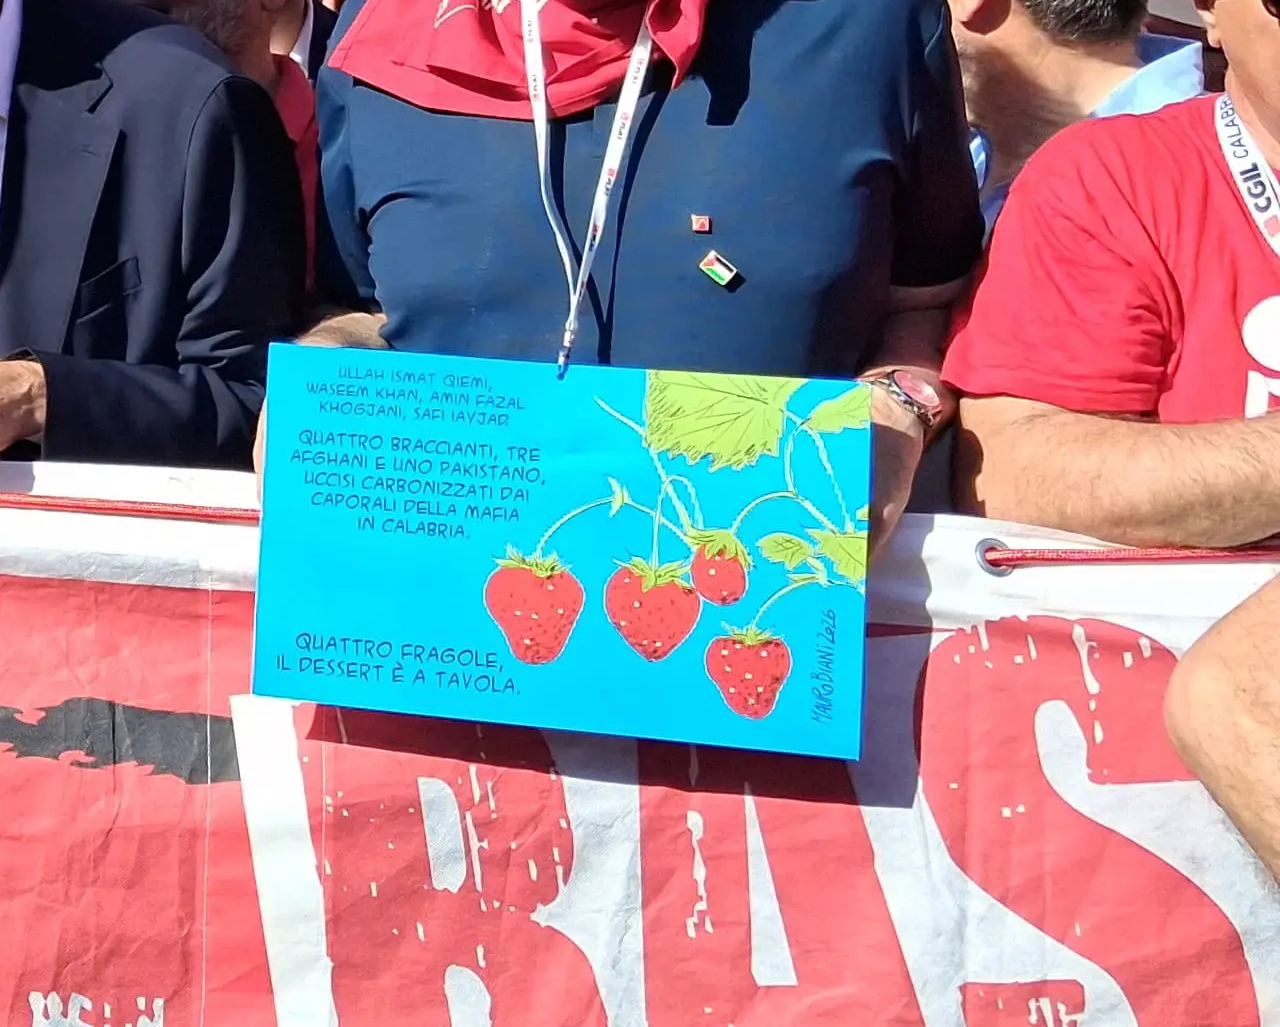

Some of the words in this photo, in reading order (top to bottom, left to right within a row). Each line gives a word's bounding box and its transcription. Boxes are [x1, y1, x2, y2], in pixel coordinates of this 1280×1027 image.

[1239, 162, 1272, 213] CGIL
[338, 367, 384, 381] ULLAH
[391, 370, 435, 384] ISMAT
[306, 383, 369, 397] WASEEM
[375, 387, 422, 403] KHAN,
[430, 392, 470, 406] AMIN
[476, 395, 525, 410] FAZAL
[413, 408, 444, 421] SAFI
[299, 429, 384, 451] QUATTRO
[390, 436, 498, 462] BRACCIANTI,
[506, 445, 541, 462] TRE
[290, 449, 368, 469] AFGHANI
[375, 456, 386, 470] E
[393, 457, 433, 474] UNO
[439, 461, 546, 486] PAKISTANO,
[304, 471, 356, 488] UCCISI
[361, 475, 493, 501] CARBONIZZATI
[500, 487, 529, 503] DAI
[311, 492, 397, 513] CAPORALI
[403, 500, 458, 517] DELLA
[465, 505, 520, 522] MAFIA
[358, 518, 375, 531] IN
[382, 519, 470, 539] CALABRIA.
[295, 632, 393, 659] QUATTRO
[401, 644, 504, 672] FRAGOLE,
[276, 654, 291, 671] IL
[298, 657, 384, 682] DESSERT
[392, 662, 405, 683] È
[412, 672, 426, 686] A
[435, 673, 521, 695] TAVOLA.
